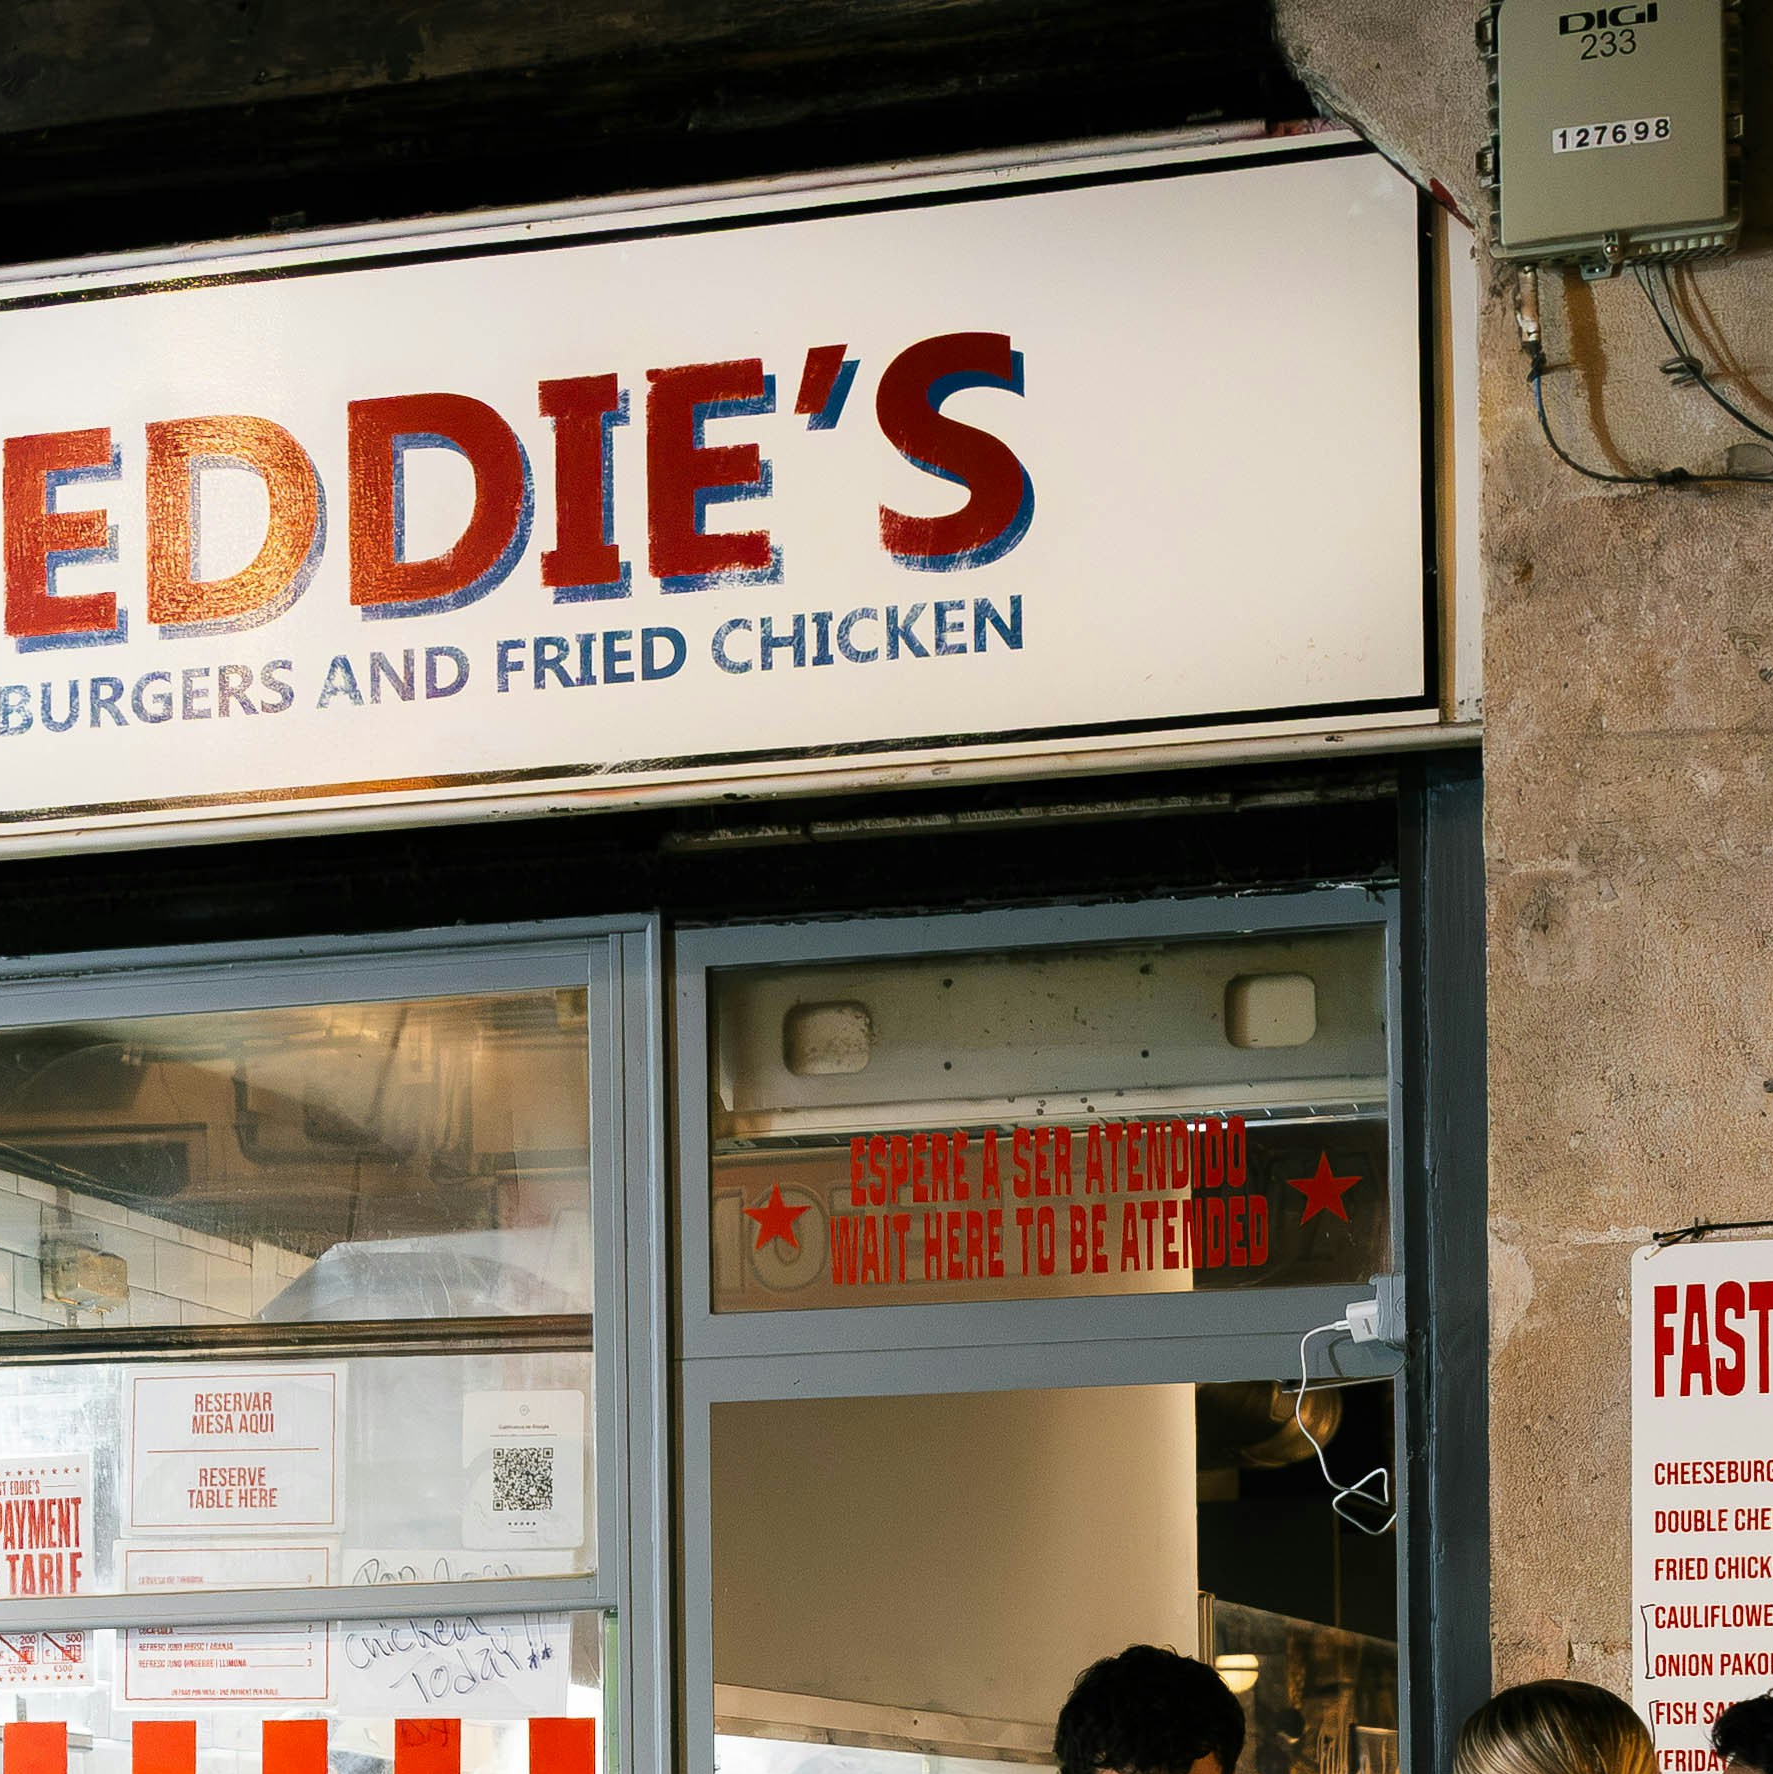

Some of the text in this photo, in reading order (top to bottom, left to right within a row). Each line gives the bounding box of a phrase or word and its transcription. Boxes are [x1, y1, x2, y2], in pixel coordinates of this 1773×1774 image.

[1559, 2, 1658, 35] DIGI
[1580, 29, 1637, 60] 233
[1559, 119, 1670, 149] 127698
[1, 328, 1033, 652] EDDIE'S
[315, 641, 471, 711] AND
[494, 624, 687, 695] FRIED
[710, 594, 1024, 676] CHICKEN
[850, 1116, 1247, 1207] ESPERE A SER ATENDIDO
[829, 1213, 913, 1286] WAIT
[924, 1209, 1005, 1282] HERE
[1017, 1204, 1056, 1277] TO
[1069, 1202, 1108, 1275] BE
[1120, 1195, 1270, 1274] ATENDED
[194, 1391, 273, 1413] RESERVAR
[191, 1412, 274, 1434] MESA AQUI
[198, 1466, 267, 1487] RESERVE
[187, 1487, 279, 1509] TABLE HERE
[1654, 1508, 1728, 1534] DOUBLE
[1654, 1557, 1709, 1582] FRIED
[1654, 1653, 1714, 1678] ONION
[1655, 1701, 1697, 1725] FISH
